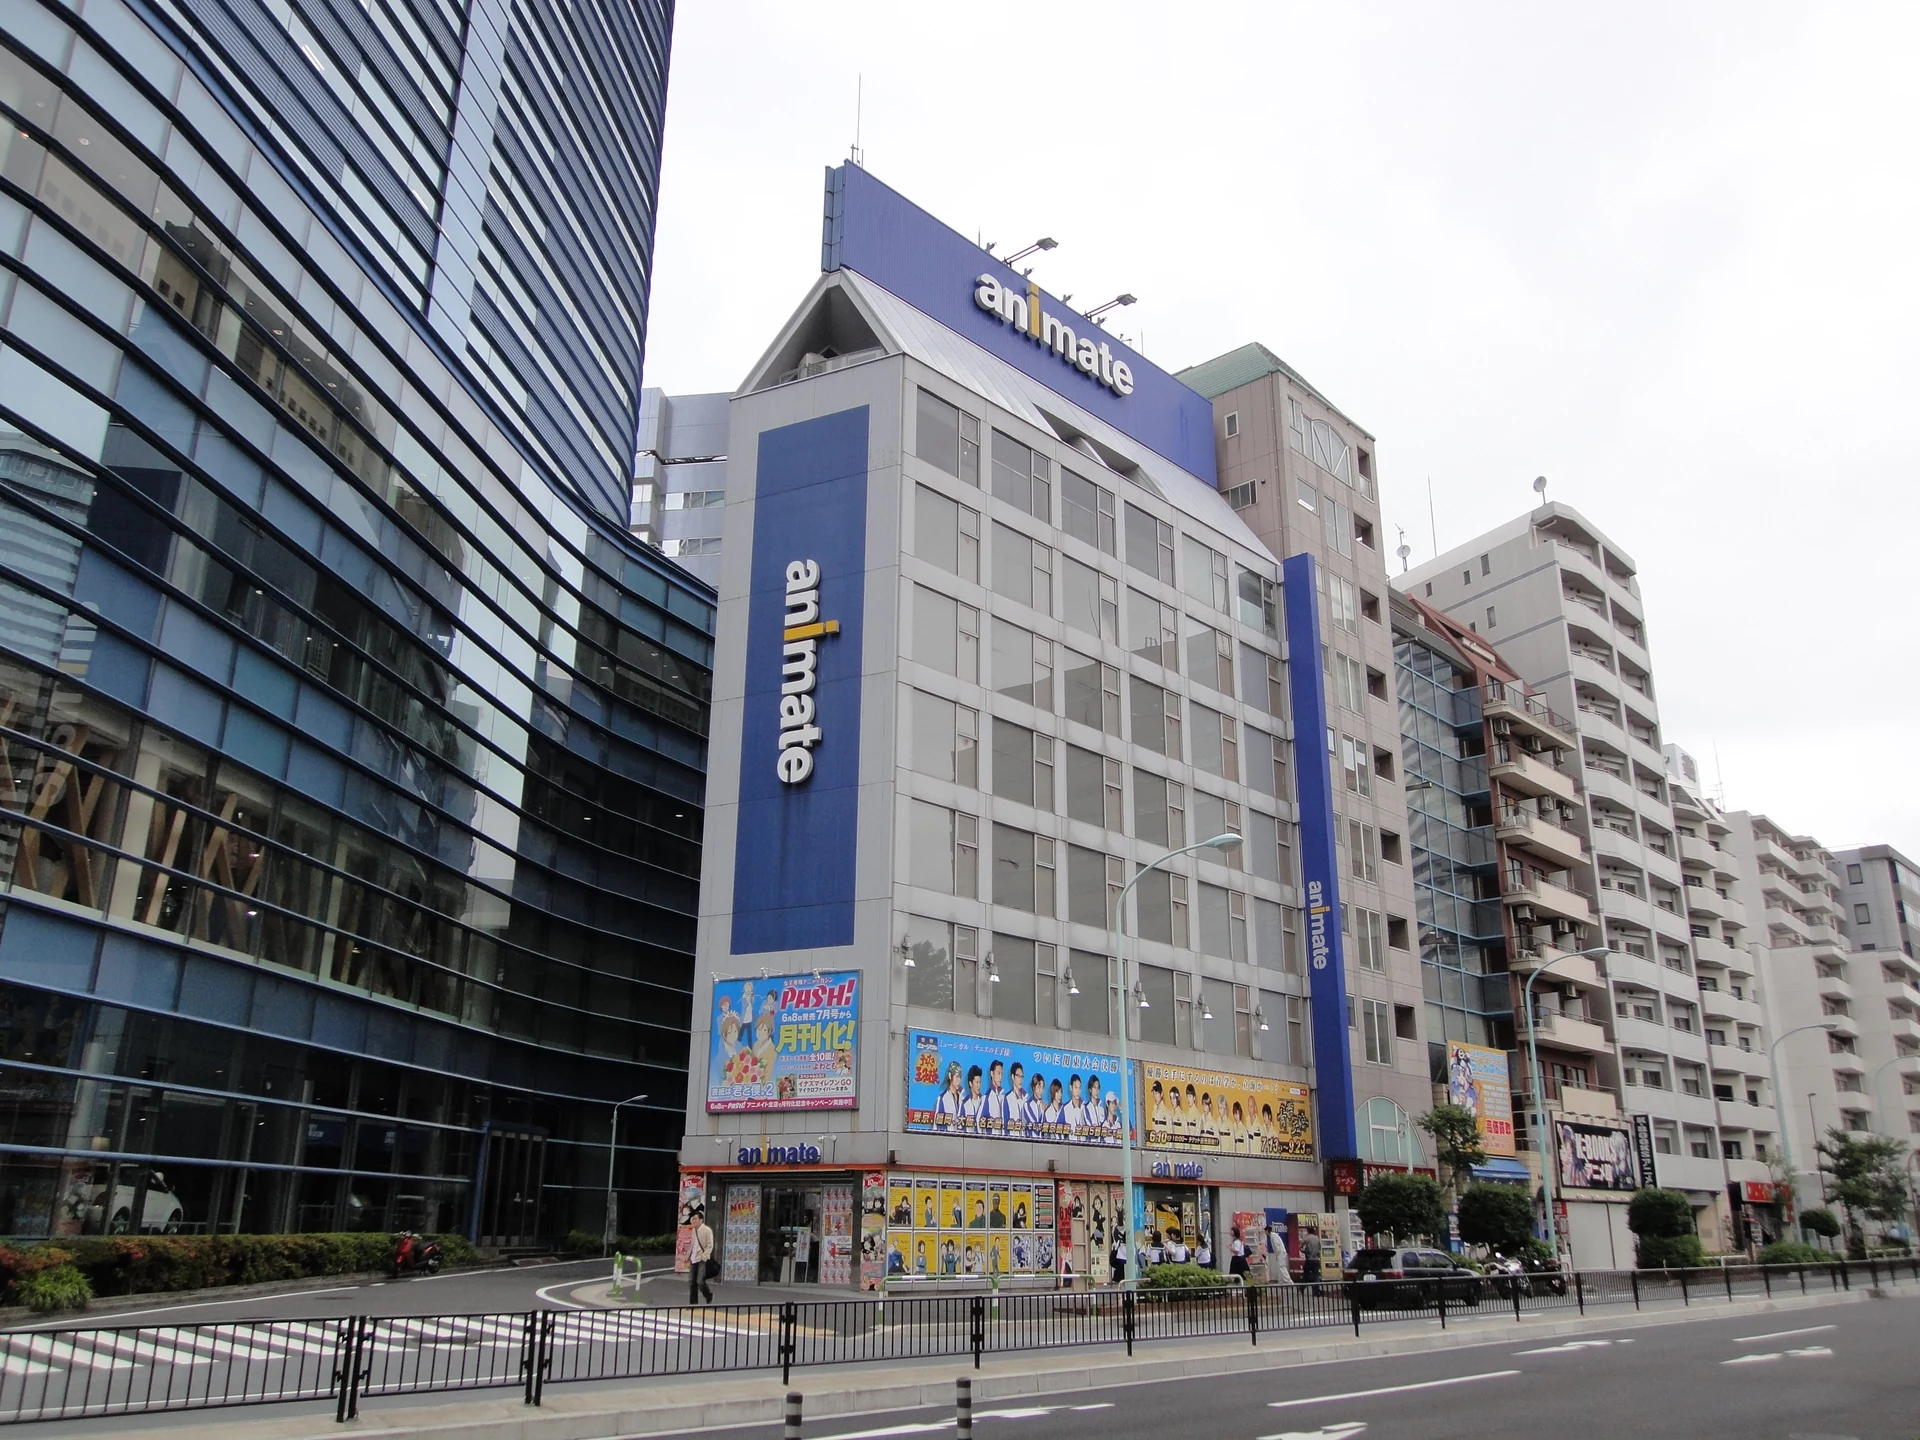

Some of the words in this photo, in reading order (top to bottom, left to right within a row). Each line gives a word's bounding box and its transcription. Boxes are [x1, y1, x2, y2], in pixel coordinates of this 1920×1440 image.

[975, 273, 1134, 397] animate
[777, 559, 839, 784] animate
[1309, 881, 1330, 969] animate
[780, 978, 856, 1010] PASH!
[1033, 1052, 1133, 1077] ついに関東大会決勝。
[738, 1136, 821, 1164] animate
[1152, 1154, 1203, 1178] animate
